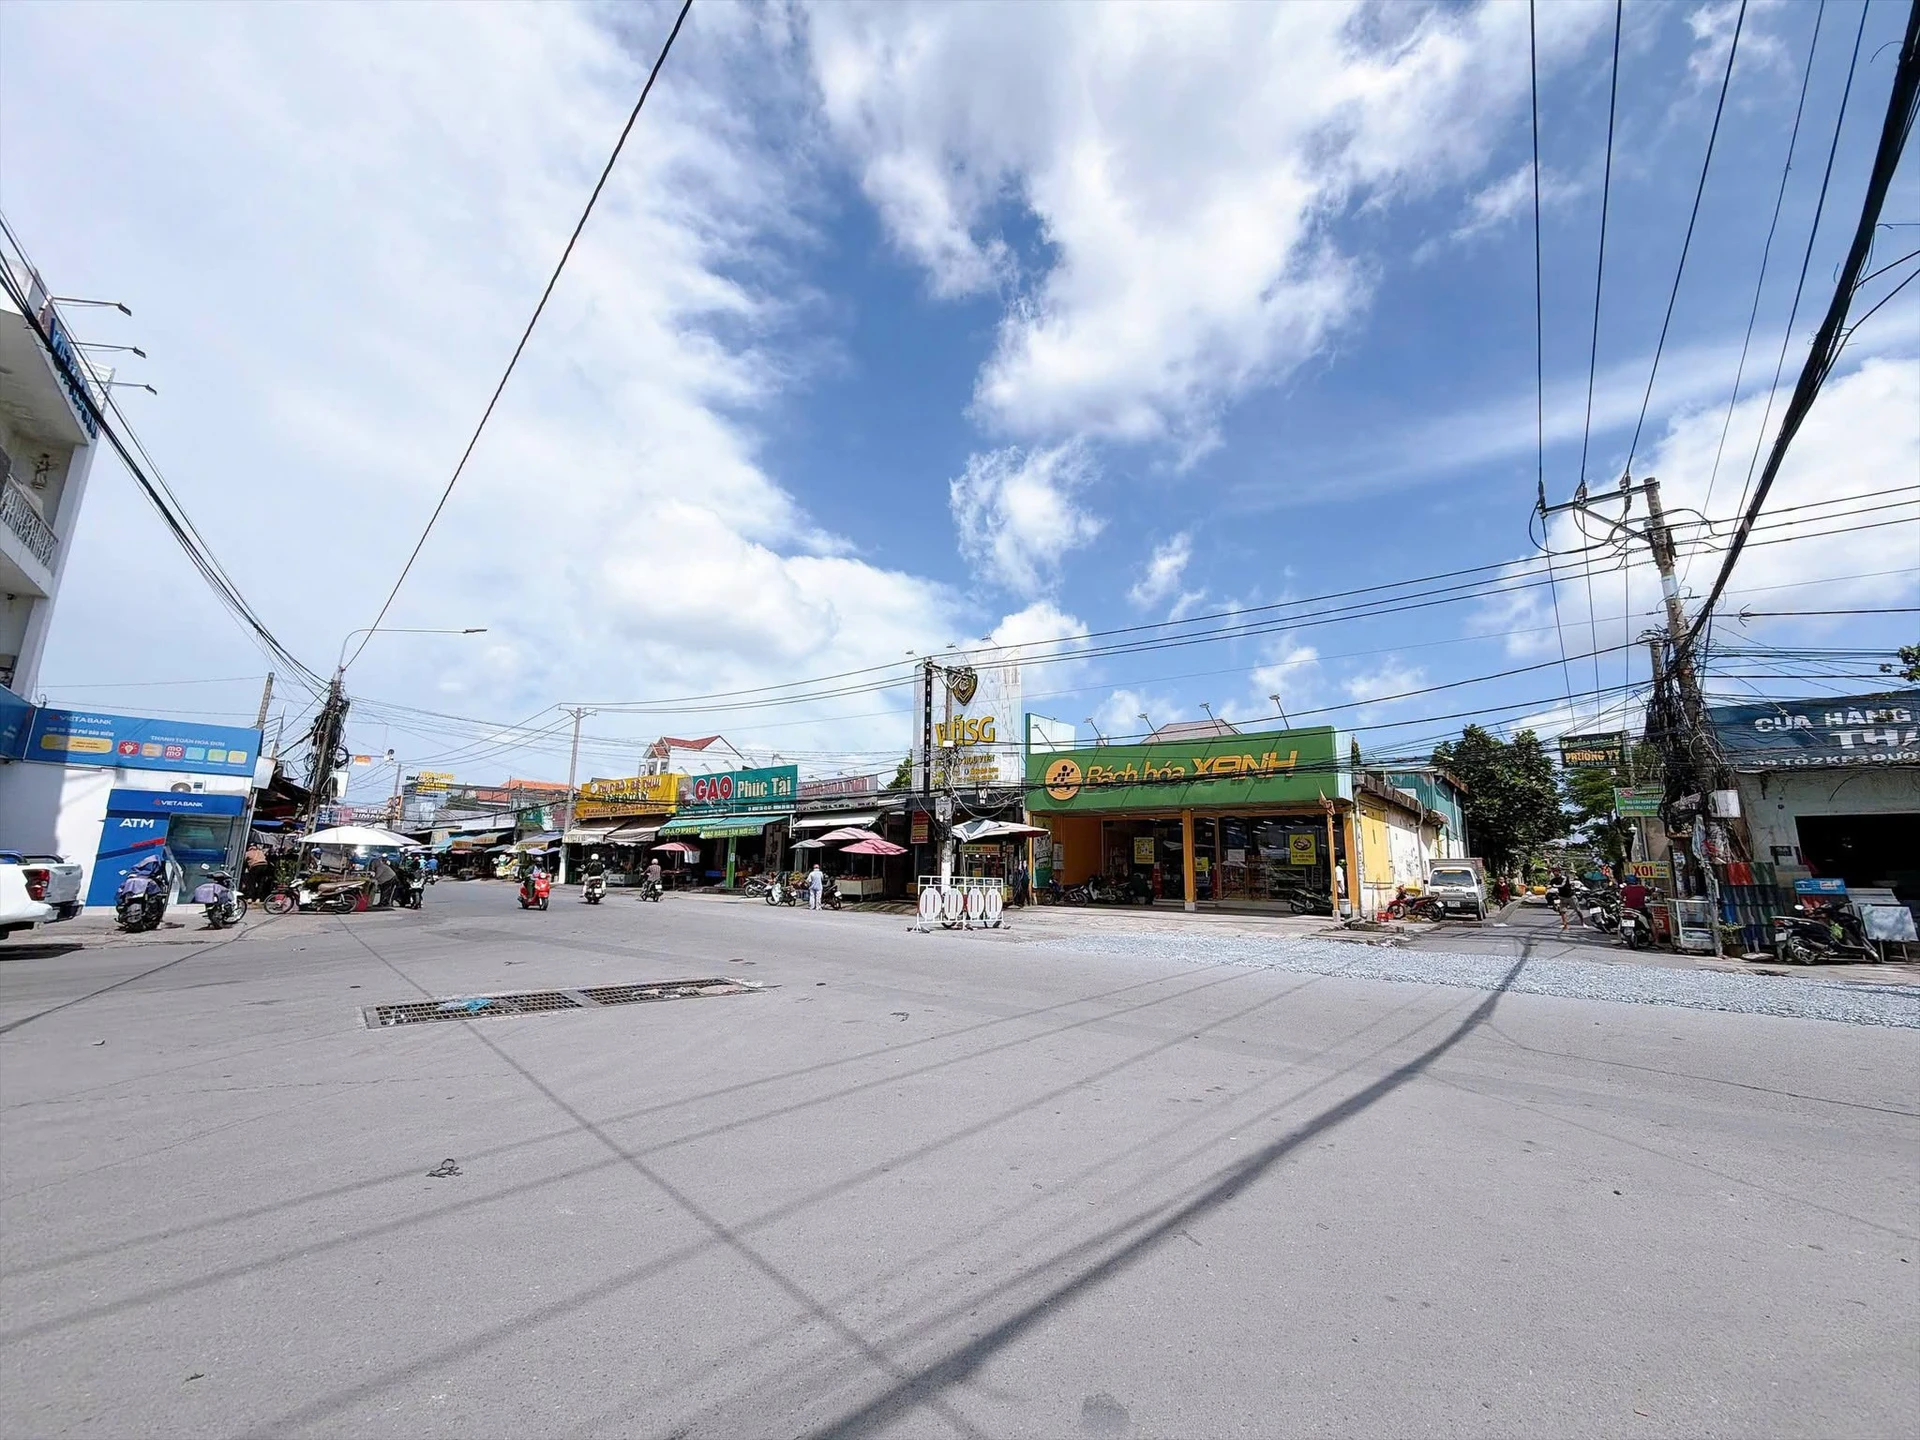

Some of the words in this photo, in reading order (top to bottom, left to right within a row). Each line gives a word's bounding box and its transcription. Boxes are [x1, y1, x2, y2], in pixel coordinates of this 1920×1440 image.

[59, 714, 112, 725] VIETABANK
[1825, 707, 1912, 728] HÀNG
[1086, 765, 1139, 788] Bách
[1143, 761, 1186, 783] hóa
[1192, 750, 1298, 783] XANH
[737, 778, 768, 799] Phúc
[771, 776, 792, 797] Tài
[161, 800, 203, 808] VIETABANK
[119, 818, 155, 829] ATM
